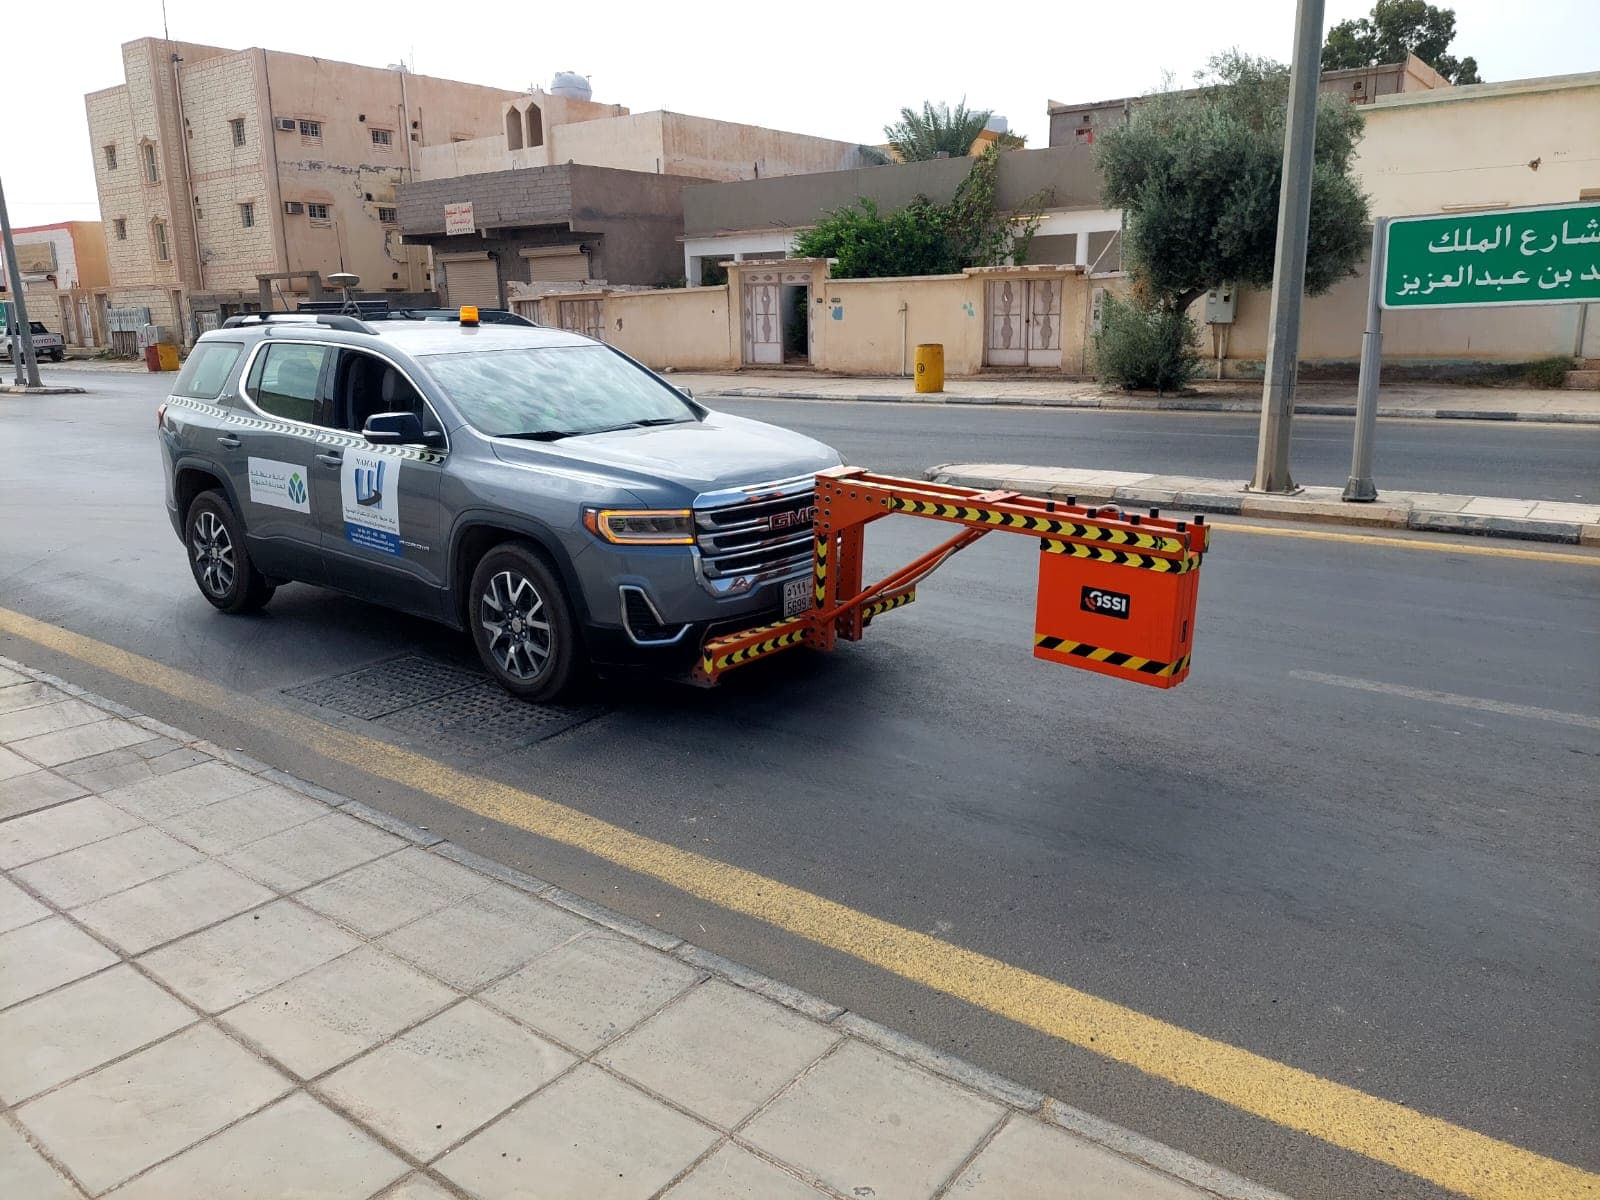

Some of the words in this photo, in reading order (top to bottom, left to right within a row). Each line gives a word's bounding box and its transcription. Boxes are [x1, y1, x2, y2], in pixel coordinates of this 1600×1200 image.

[1428, 224, 1511, 253] الملك
[1520, 218, 1600, 256] شارع
[1538, 267, 1572, 289] بن
[1085, 590, 1127, 612] GSSI
